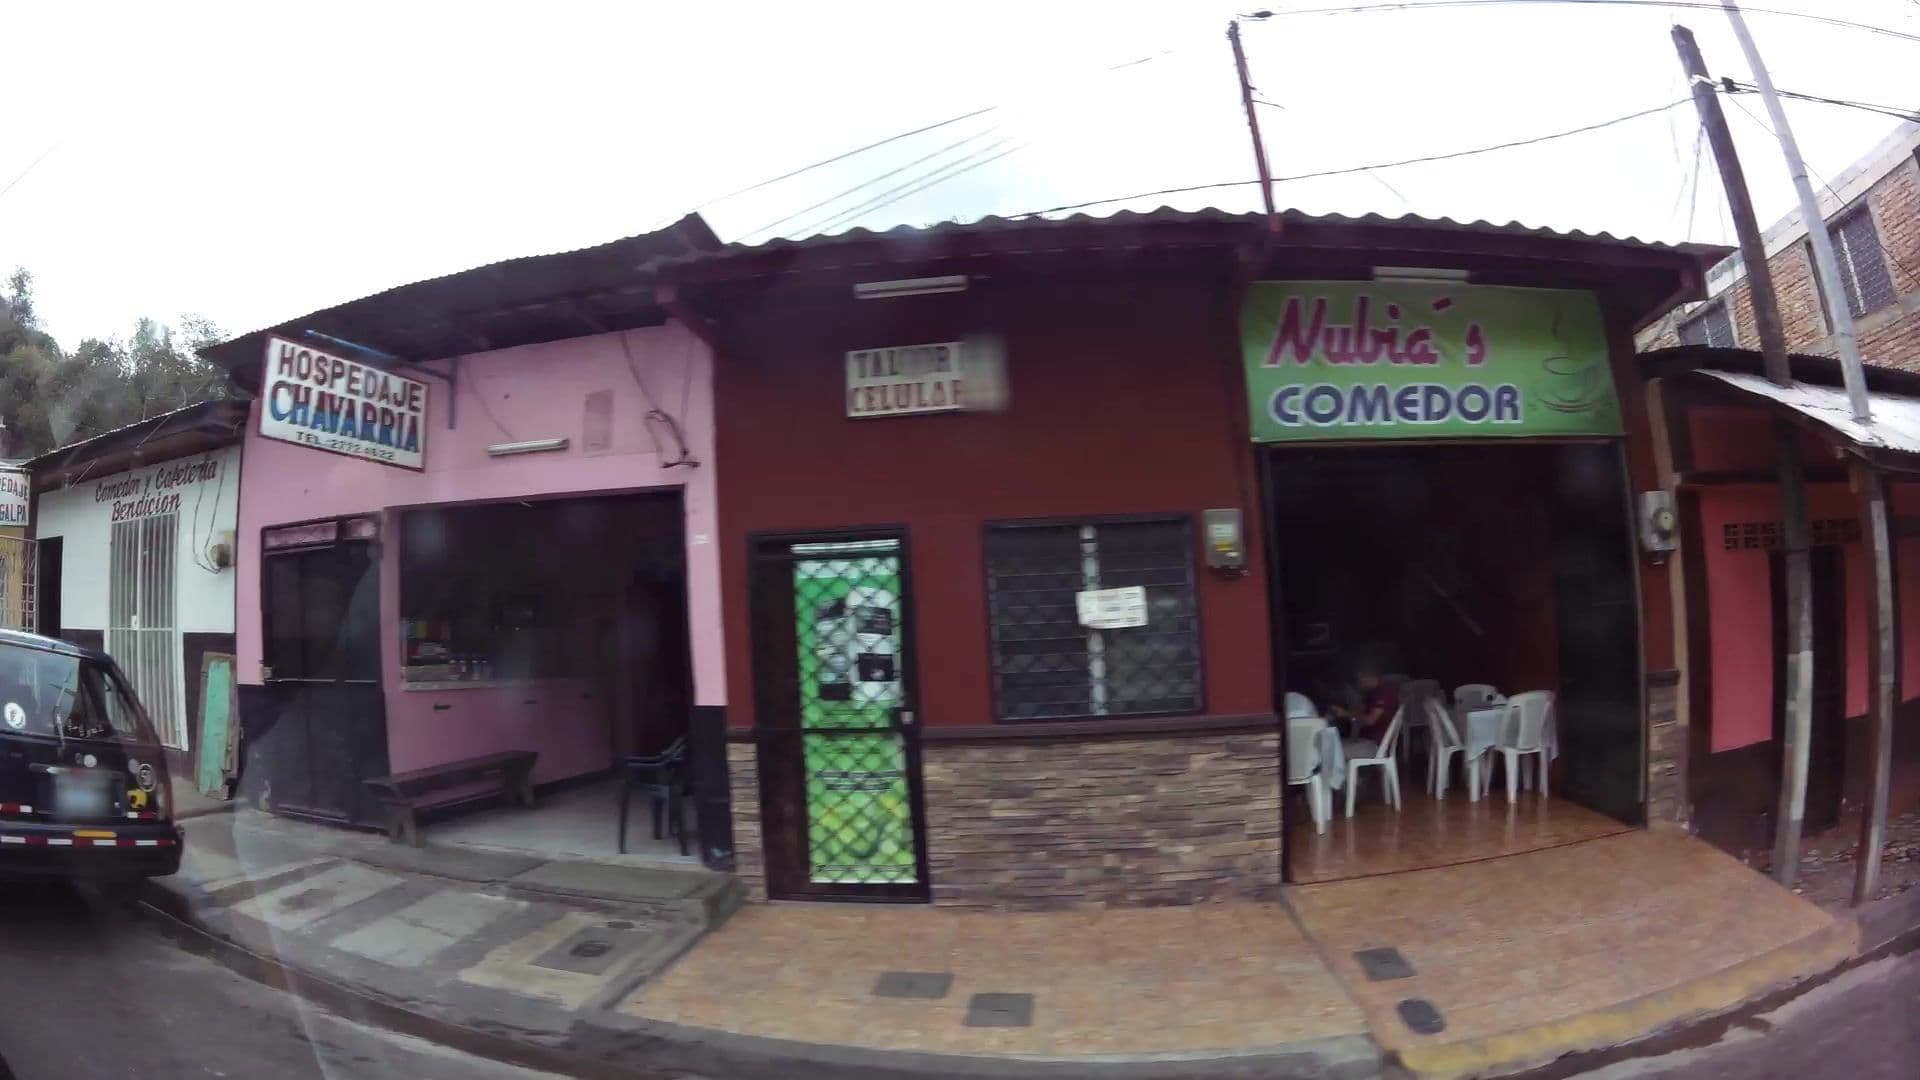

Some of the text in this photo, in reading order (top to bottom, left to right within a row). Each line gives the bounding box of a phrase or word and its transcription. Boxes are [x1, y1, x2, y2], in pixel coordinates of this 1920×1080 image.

[277, 343, 422, 412] HOSPEDAJE
[270, 380, 420, 453] CHAVARRIA
[1272, 384, 1520, 424] COMEDOR
[0, 476, 28, 501] EDAJE
[95, 474, 140, 503] Comedor
